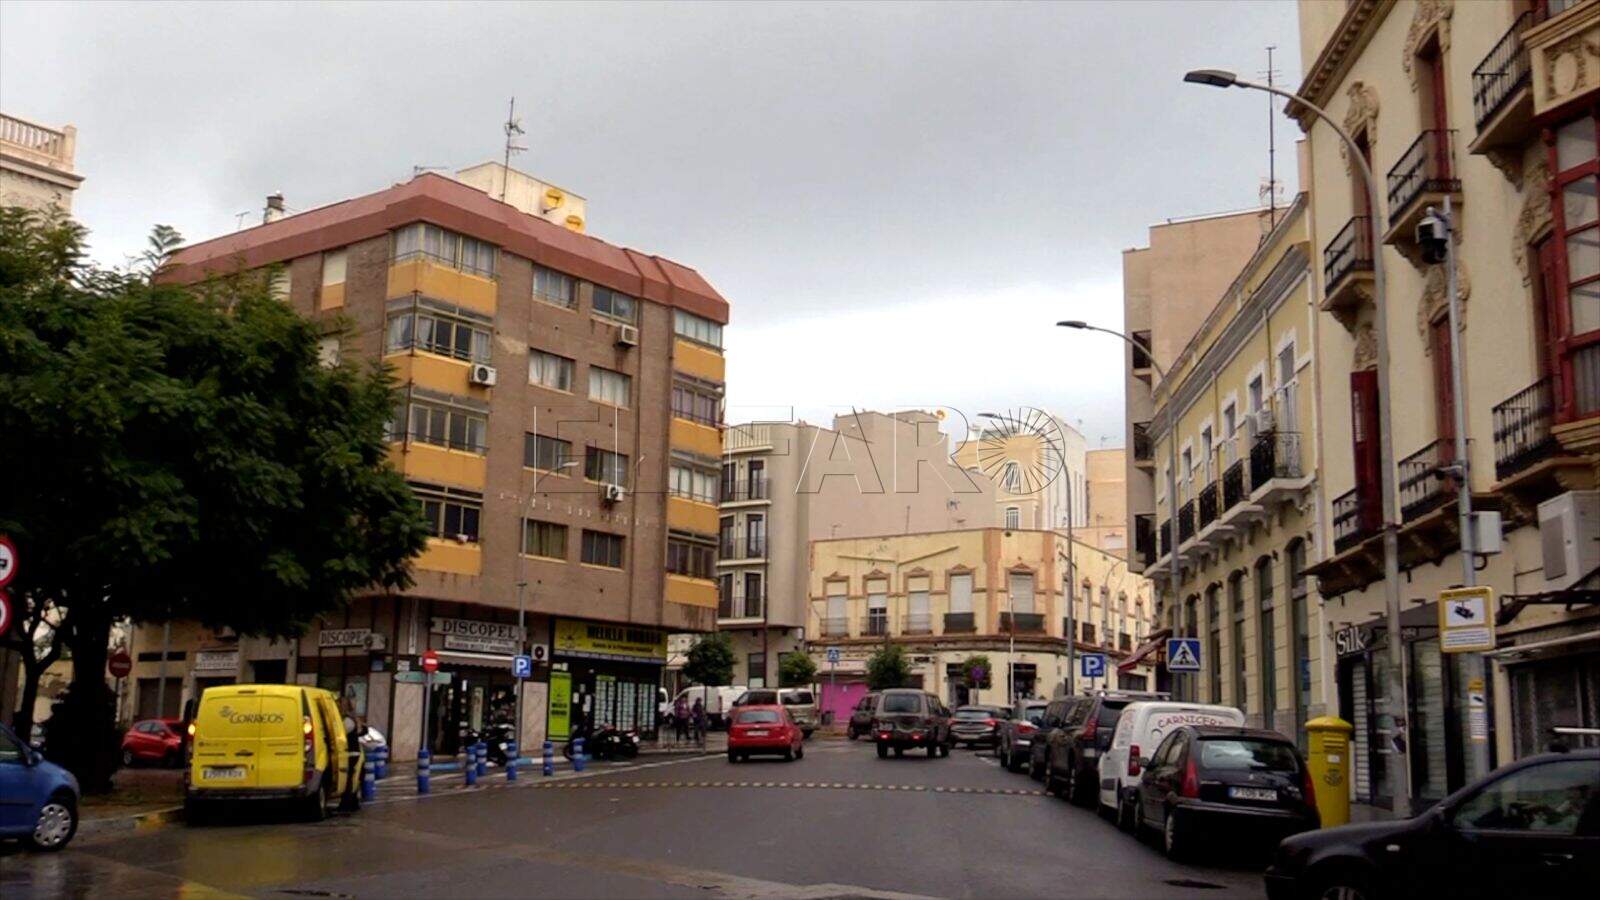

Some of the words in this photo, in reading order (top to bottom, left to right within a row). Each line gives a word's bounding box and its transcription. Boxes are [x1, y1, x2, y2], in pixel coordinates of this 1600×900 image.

[321, 631, 366, 645] DISCOPE
[443, 621, 516, 639] DISCOPEL
[1337, 626, 1365, 655] Silk
[515, 658, 527, 673] P
[1085, 657, 1100, 675] P
[230, 712, 284, 724] CORREOS
